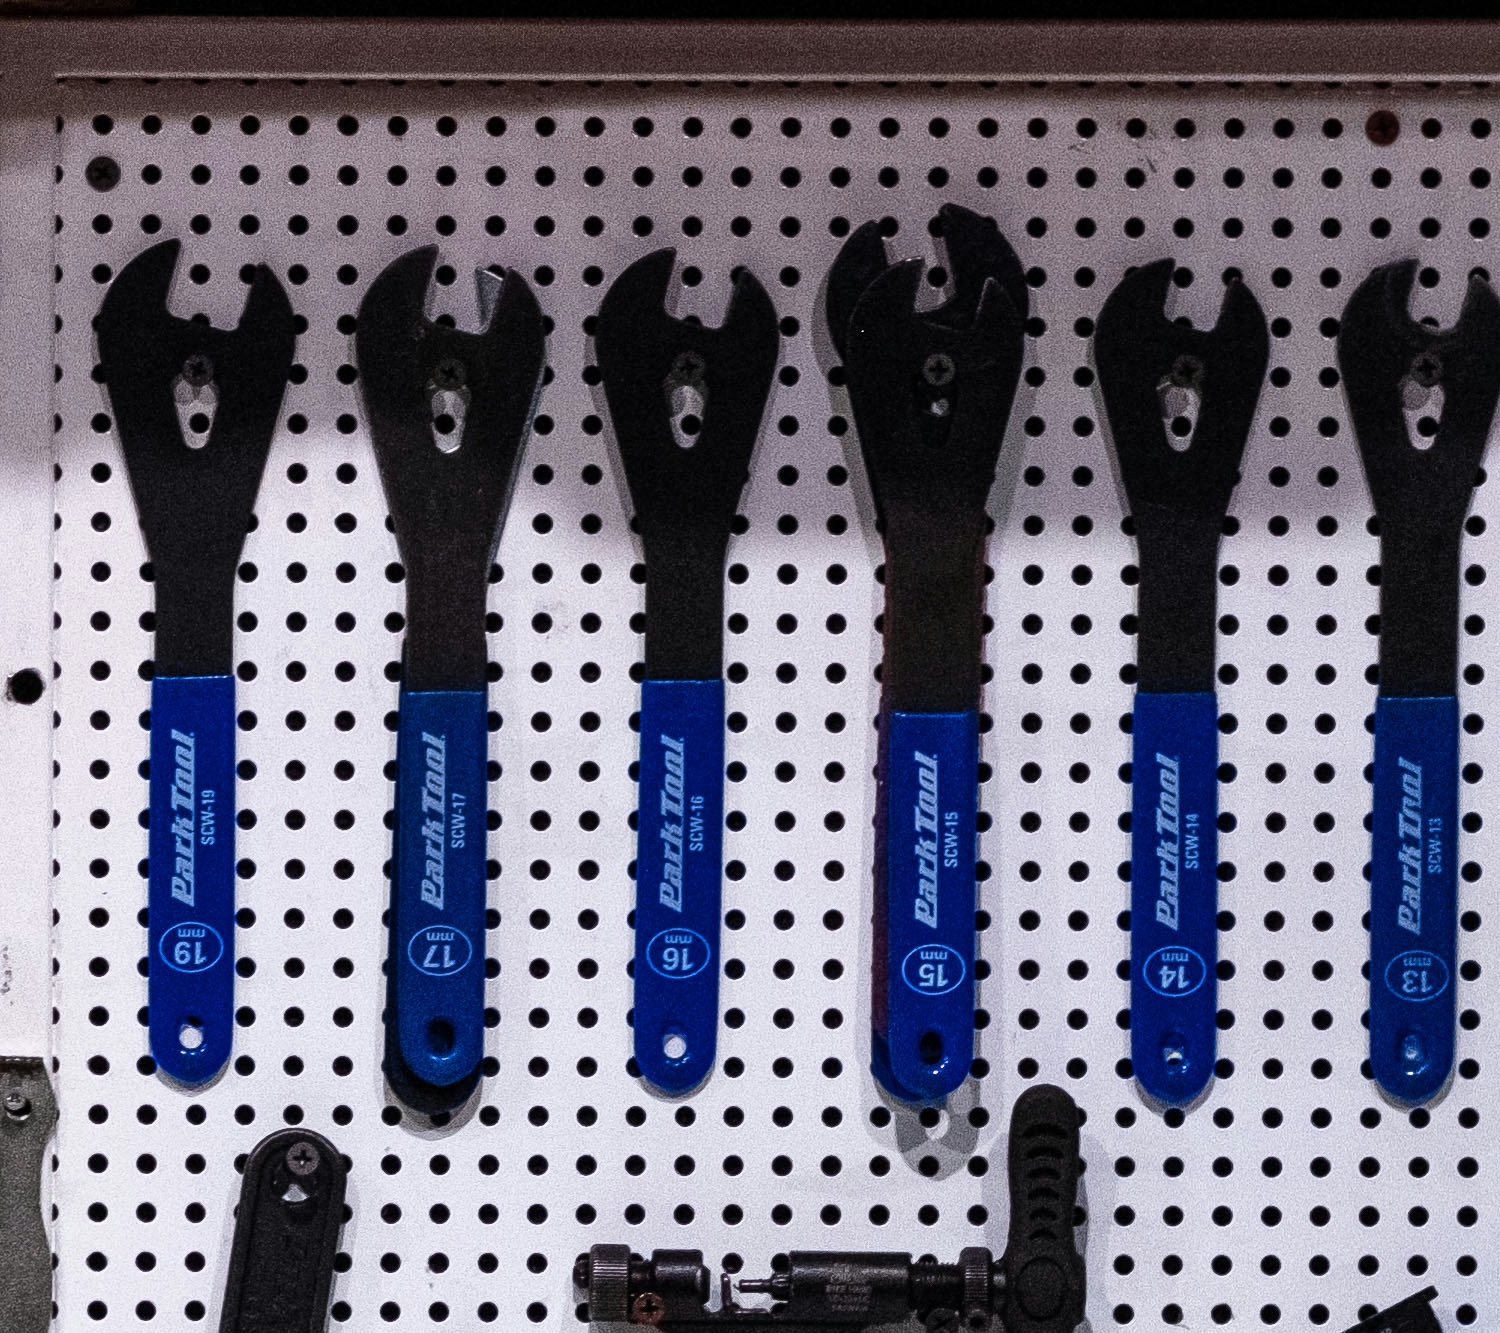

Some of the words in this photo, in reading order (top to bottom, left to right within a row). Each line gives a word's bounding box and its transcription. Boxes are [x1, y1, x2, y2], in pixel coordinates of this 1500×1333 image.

[201, 789, 216, 846] SCW-19
[452, 792, 467, 849] SCW-17
[690, 795, 706, 852] SCW-16
[944, 811, 959, 868] SCW-15
[1185, 813, 1200, 870] SCW-14
[1428, 816, 1443, 874] SCW-13
[174, 941, 207, 965] 19
[423, 944, 457, 968] 17
[662, 947, 694, 971] 16
[919, 963, 949, 987] 15
[1159, 965, 1191, 989] 14
[1402, 970, 1433, 994] 13
